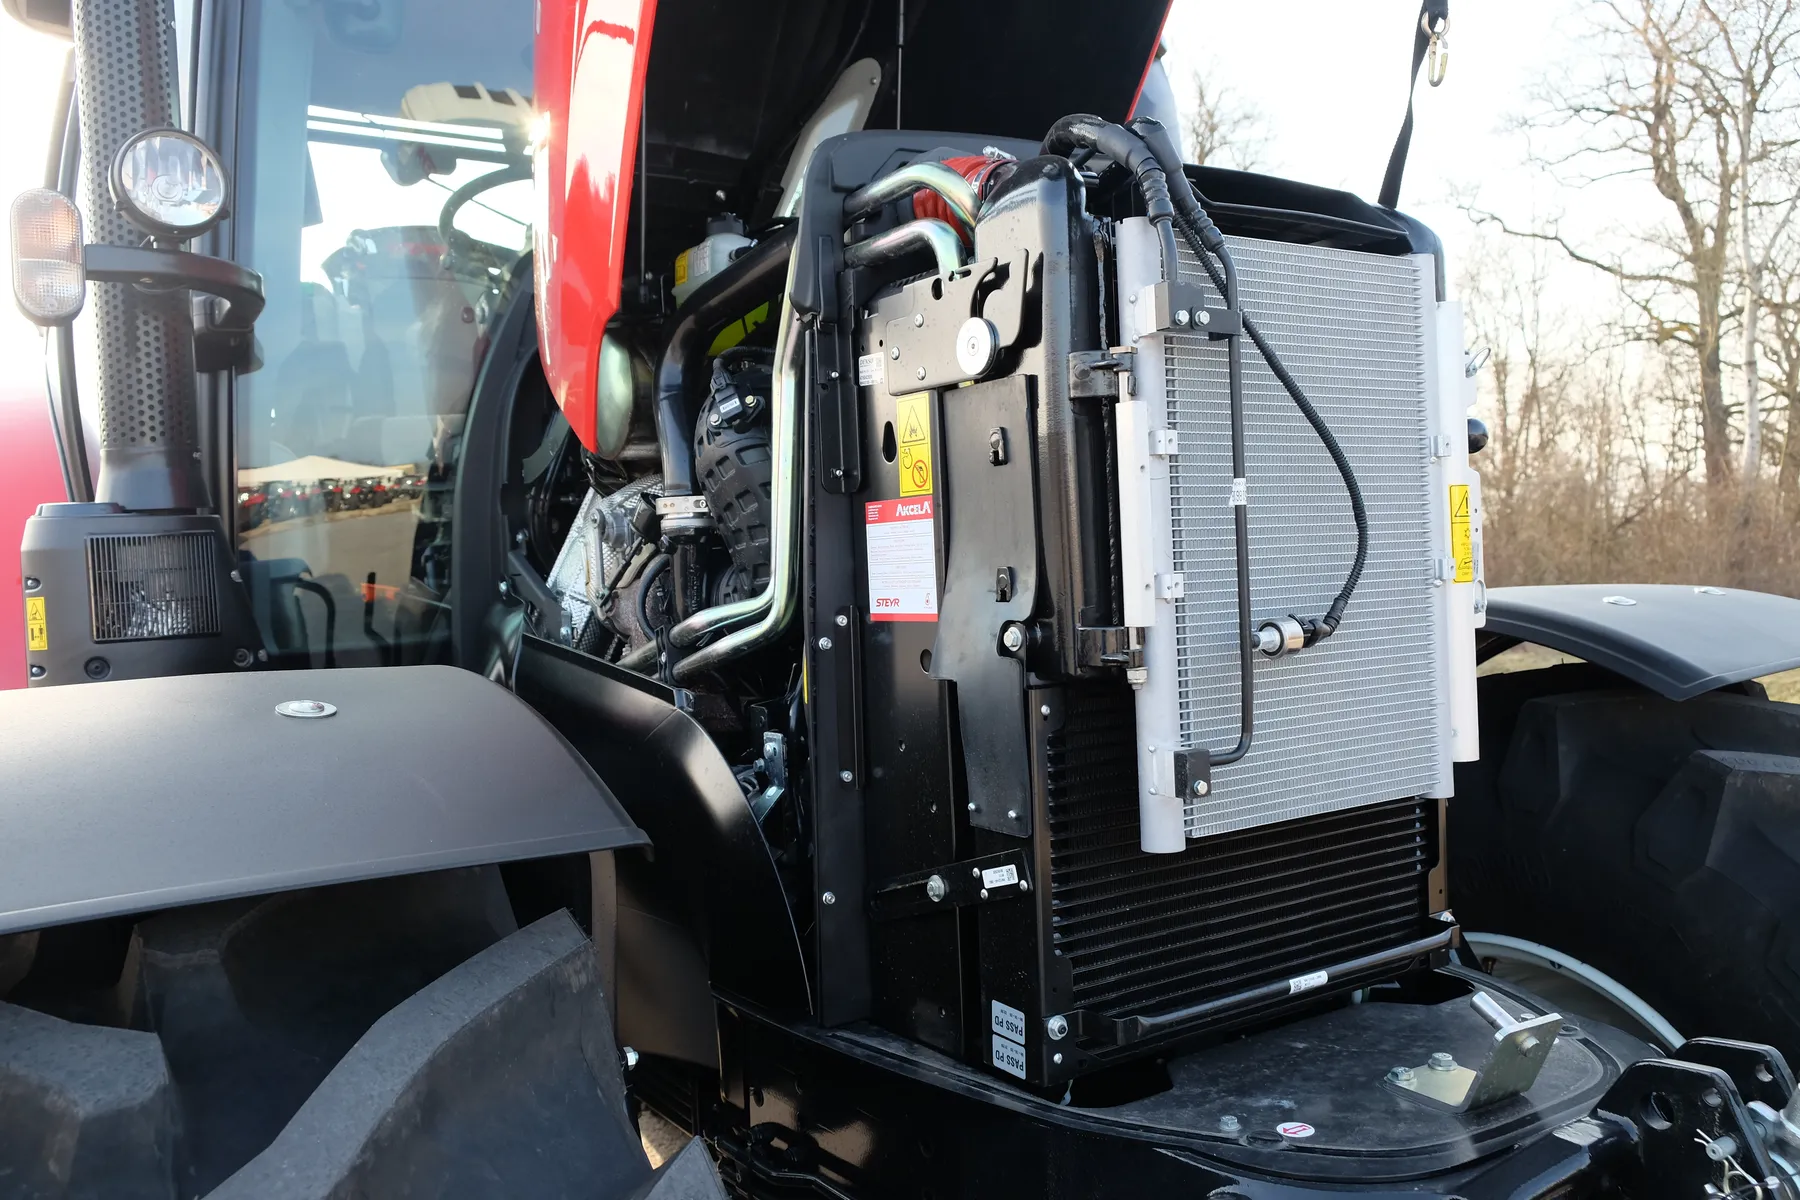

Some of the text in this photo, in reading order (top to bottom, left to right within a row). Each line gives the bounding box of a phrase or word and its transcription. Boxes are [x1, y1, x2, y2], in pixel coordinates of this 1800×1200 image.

[876, 598, 900, 607] STEYR
[994, 1015, 1004, 1027] PD
[1006, 1020, 1023, 1036] PASS
[995, 1049, 1005, 1062] PD
[1006, 1055, 1024, 1071] PASS
